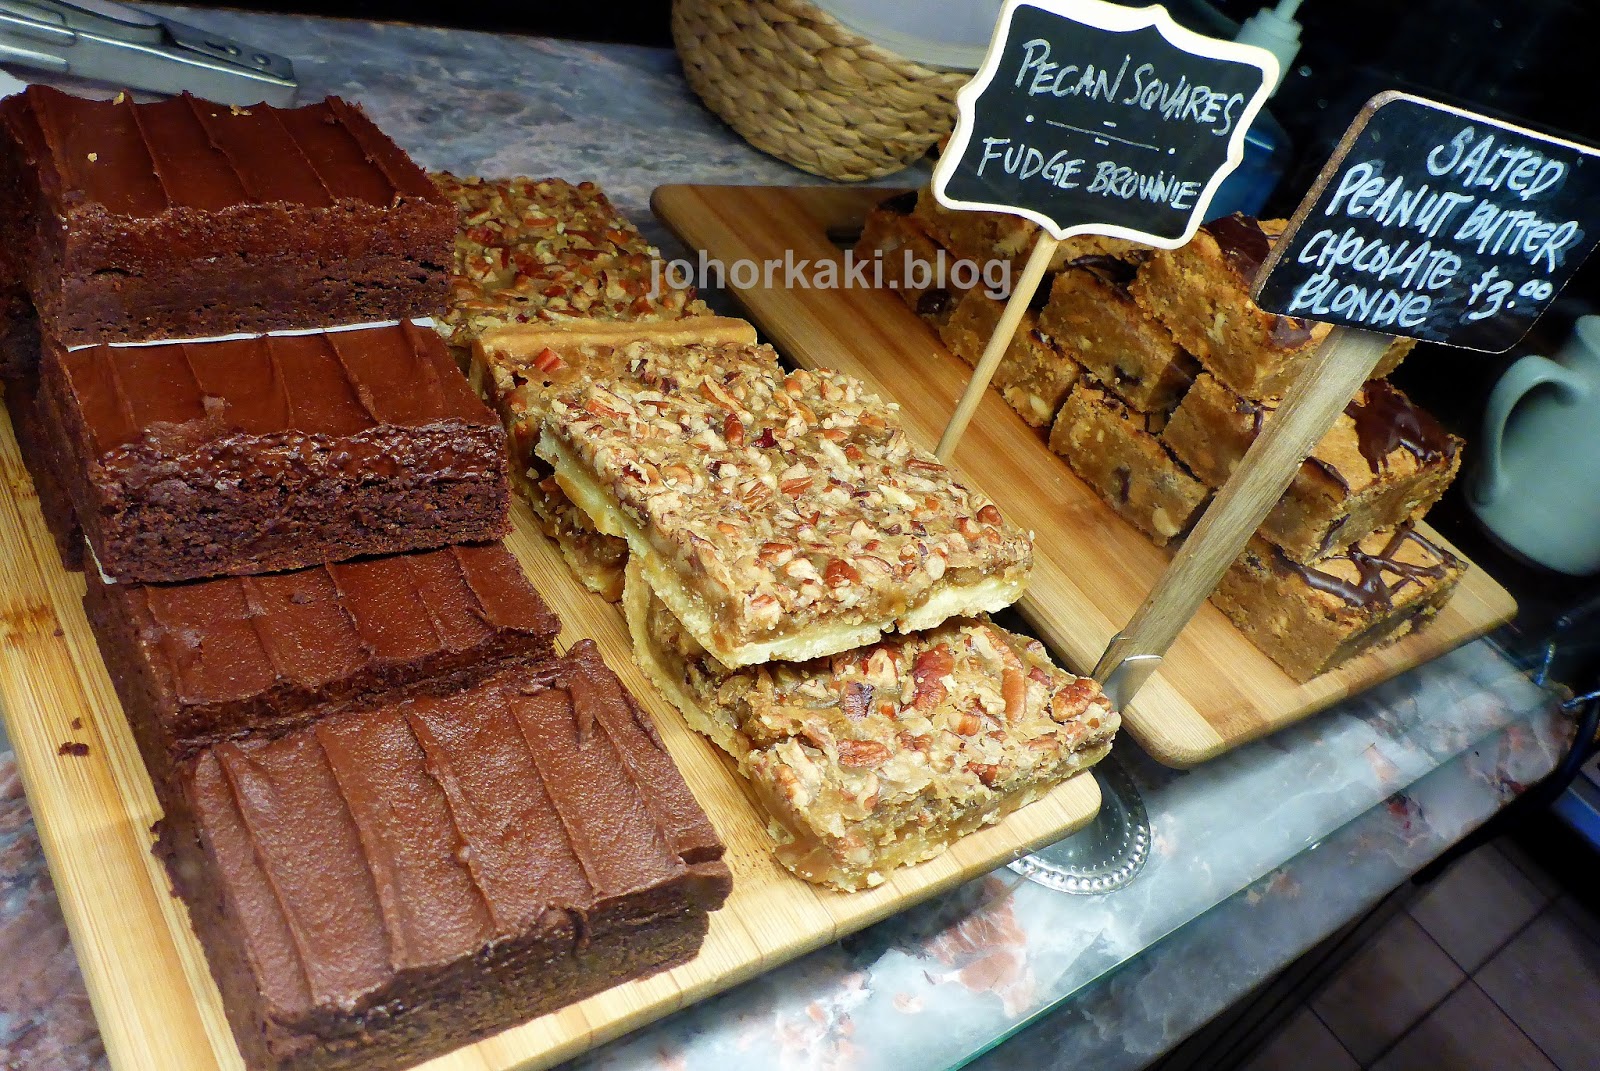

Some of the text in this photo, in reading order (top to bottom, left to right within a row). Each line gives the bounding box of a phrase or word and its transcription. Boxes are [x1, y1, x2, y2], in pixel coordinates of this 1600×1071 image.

[1015, 38, 1244, 136] PECAN SQUARES
[976, 137, 1202, 210] FUDGE BROWNIE
[1467, 265, 1554, 321] $3.00
